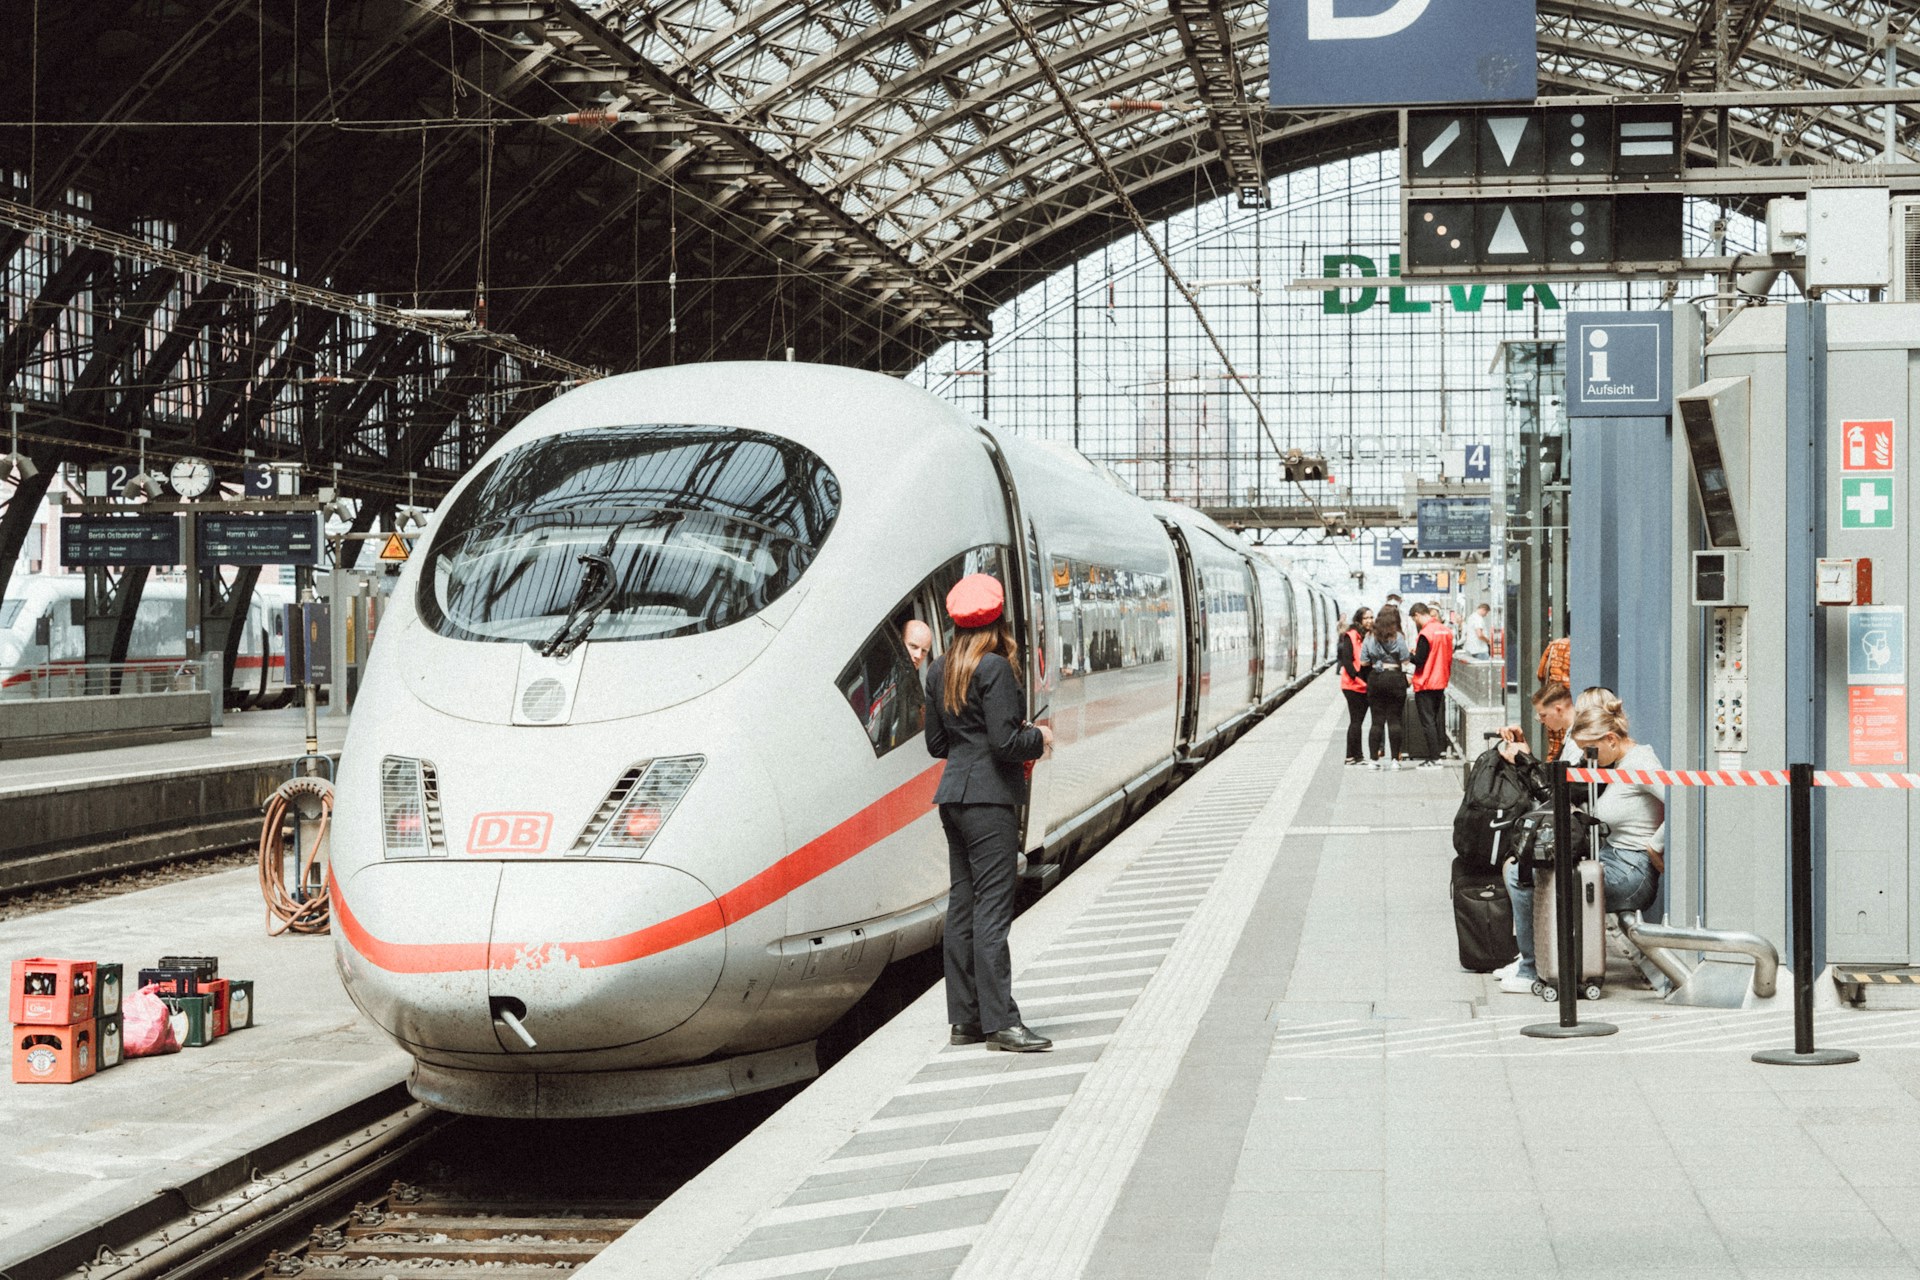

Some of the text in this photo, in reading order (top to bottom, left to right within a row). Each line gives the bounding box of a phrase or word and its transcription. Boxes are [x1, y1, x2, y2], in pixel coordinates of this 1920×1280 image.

[1587, 384, 1635, 395] Aufsicht
[1468, 445, 1487, 471] 4
[111, 465, 127, 491] 2
[255, 463, 273, 489] 3
[88, 532, 106, 540] Berlin
[107, 531, 142, 539] Ostbahnhof
[226, 530, 246, 538] Hamm
[1376, 538, 1392, 560] E
[1410, 575, 1420, 589] F
[478, 817, 541, 846] DB
